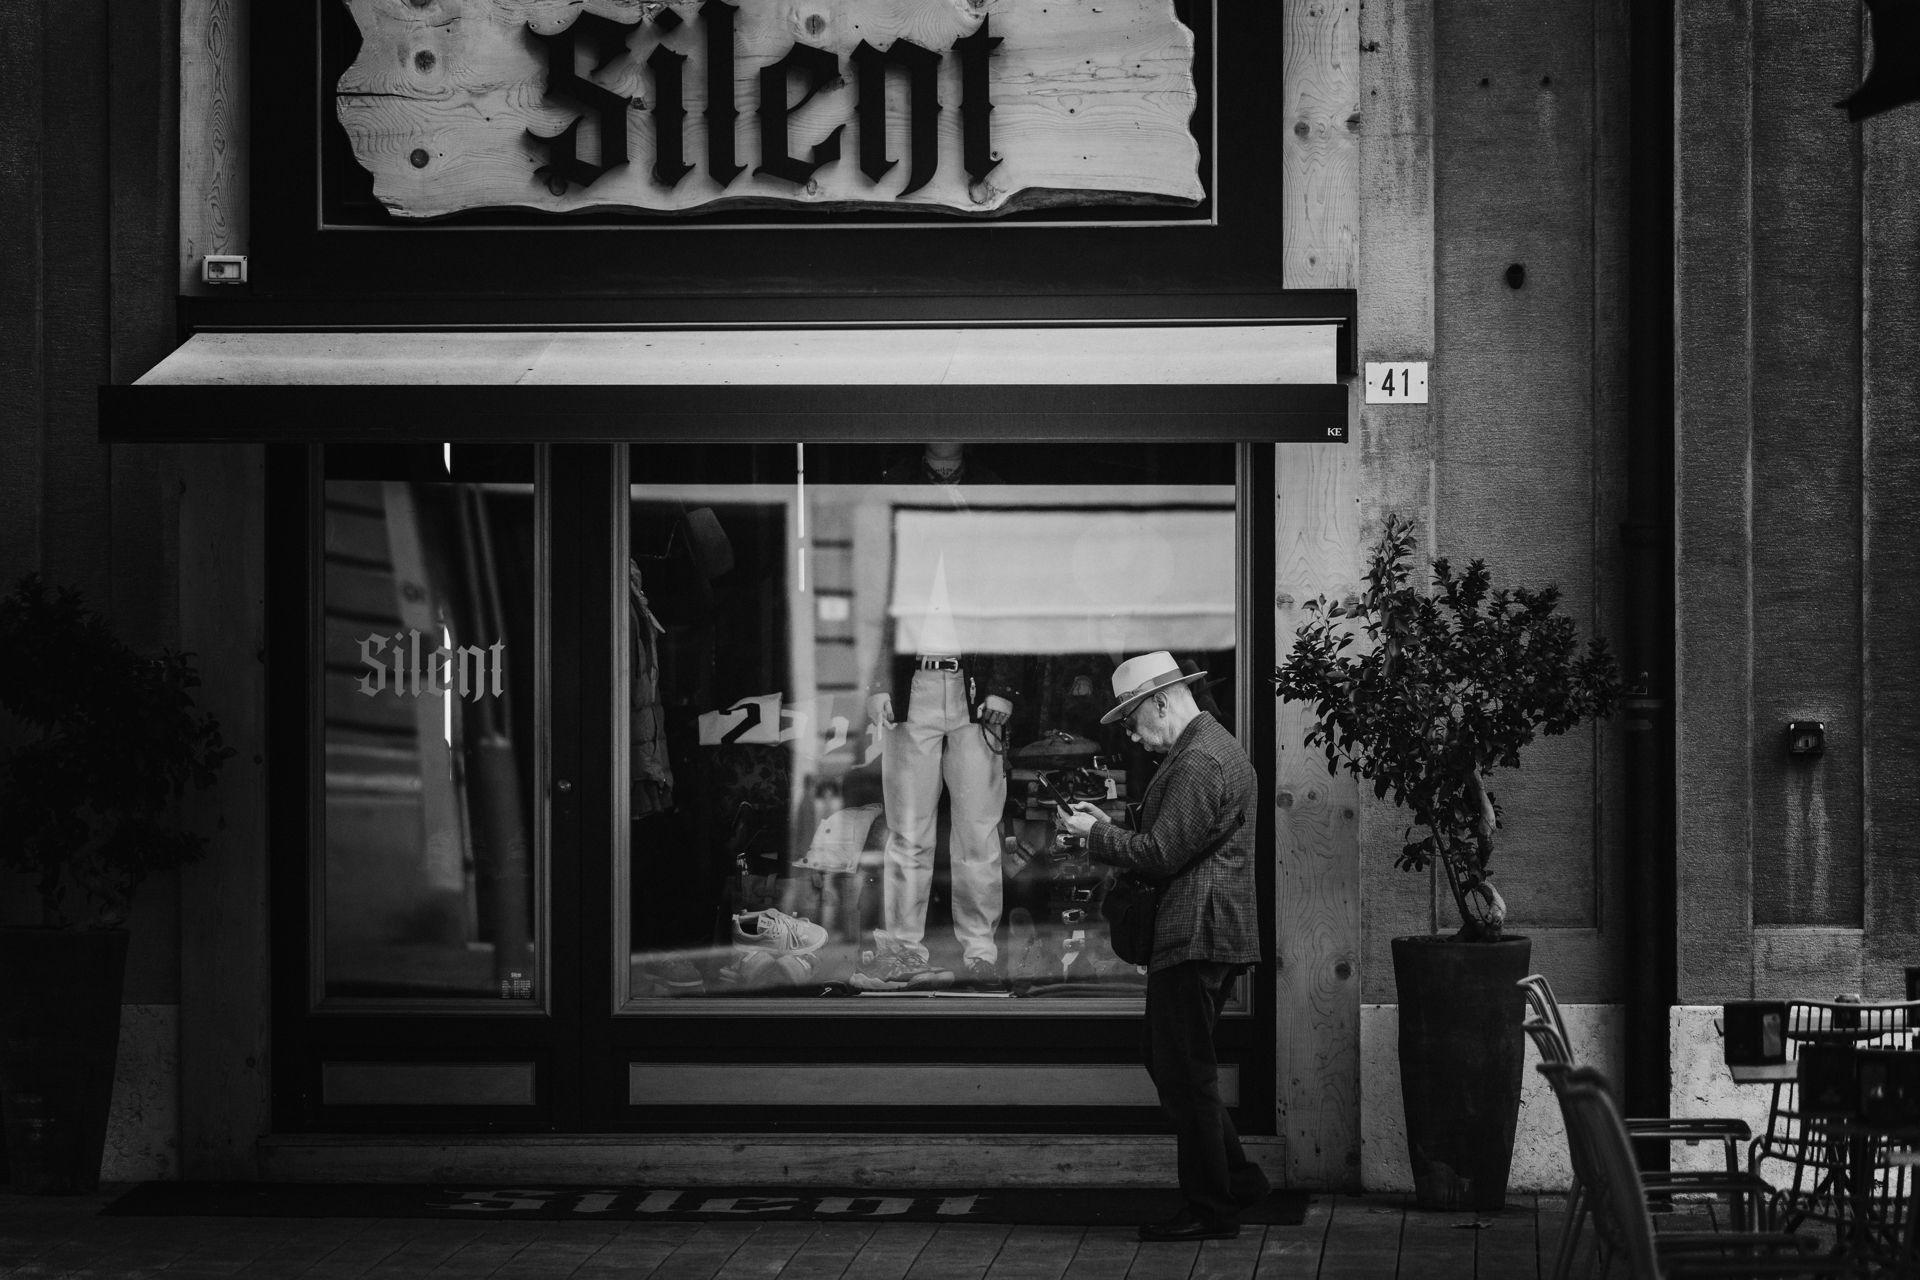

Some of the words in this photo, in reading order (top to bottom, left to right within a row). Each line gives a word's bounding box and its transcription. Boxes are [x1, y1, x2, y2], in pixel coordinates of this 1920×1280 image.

[524, 0, 1005, 198] Silent
[1381, 368, 1409, 396] 41
[1327, 427, 1342, 436] KE
[353, 628, 507, 703] Silent
